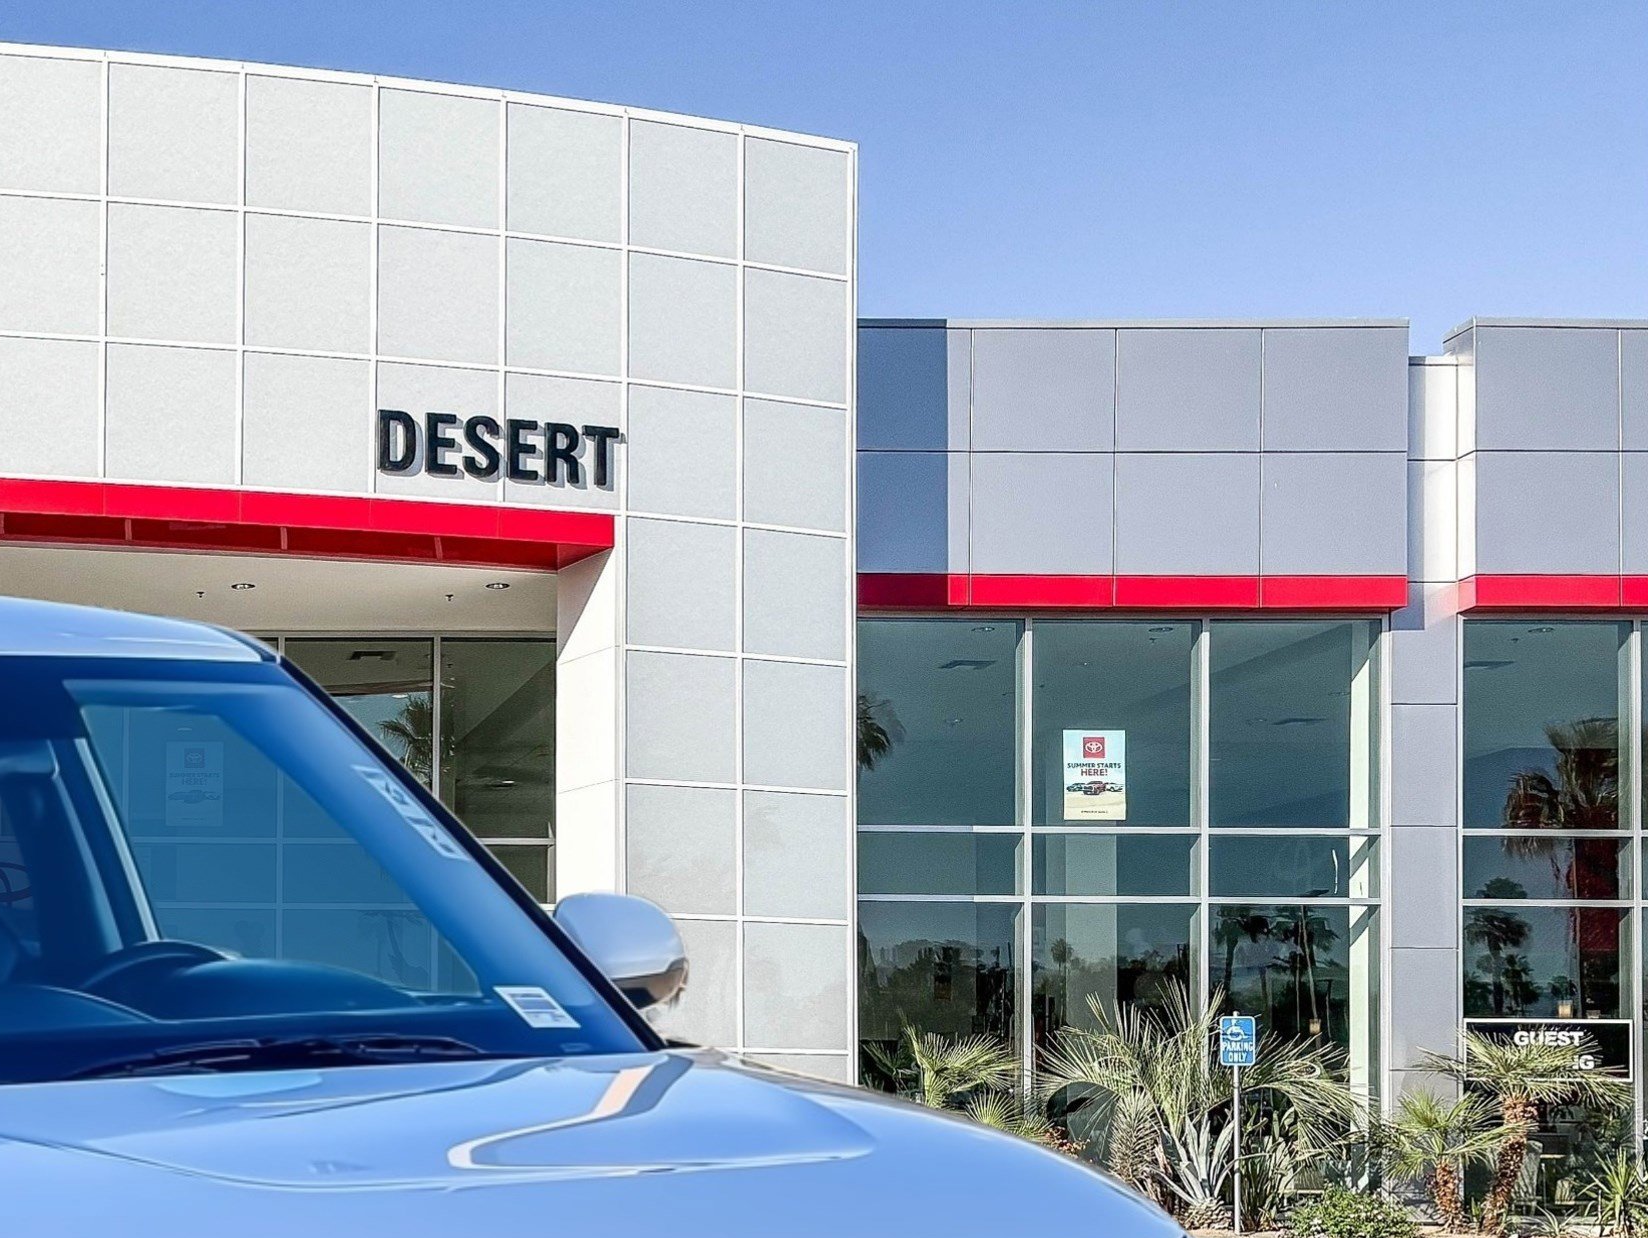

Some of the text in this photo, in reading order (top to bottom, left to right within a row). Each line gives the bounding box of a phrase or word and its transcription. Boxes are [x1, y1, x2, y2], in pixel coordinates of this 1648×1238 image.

[377, 409, 620, 486] DESERT
[1080, 768, 1108, 776] HERE!
[1513, 1030, 1584, 1047] GUEST
[1222, 1041, 1254, 1052] PARKING
[1228, 1052, 1248, 1062] ONLY
